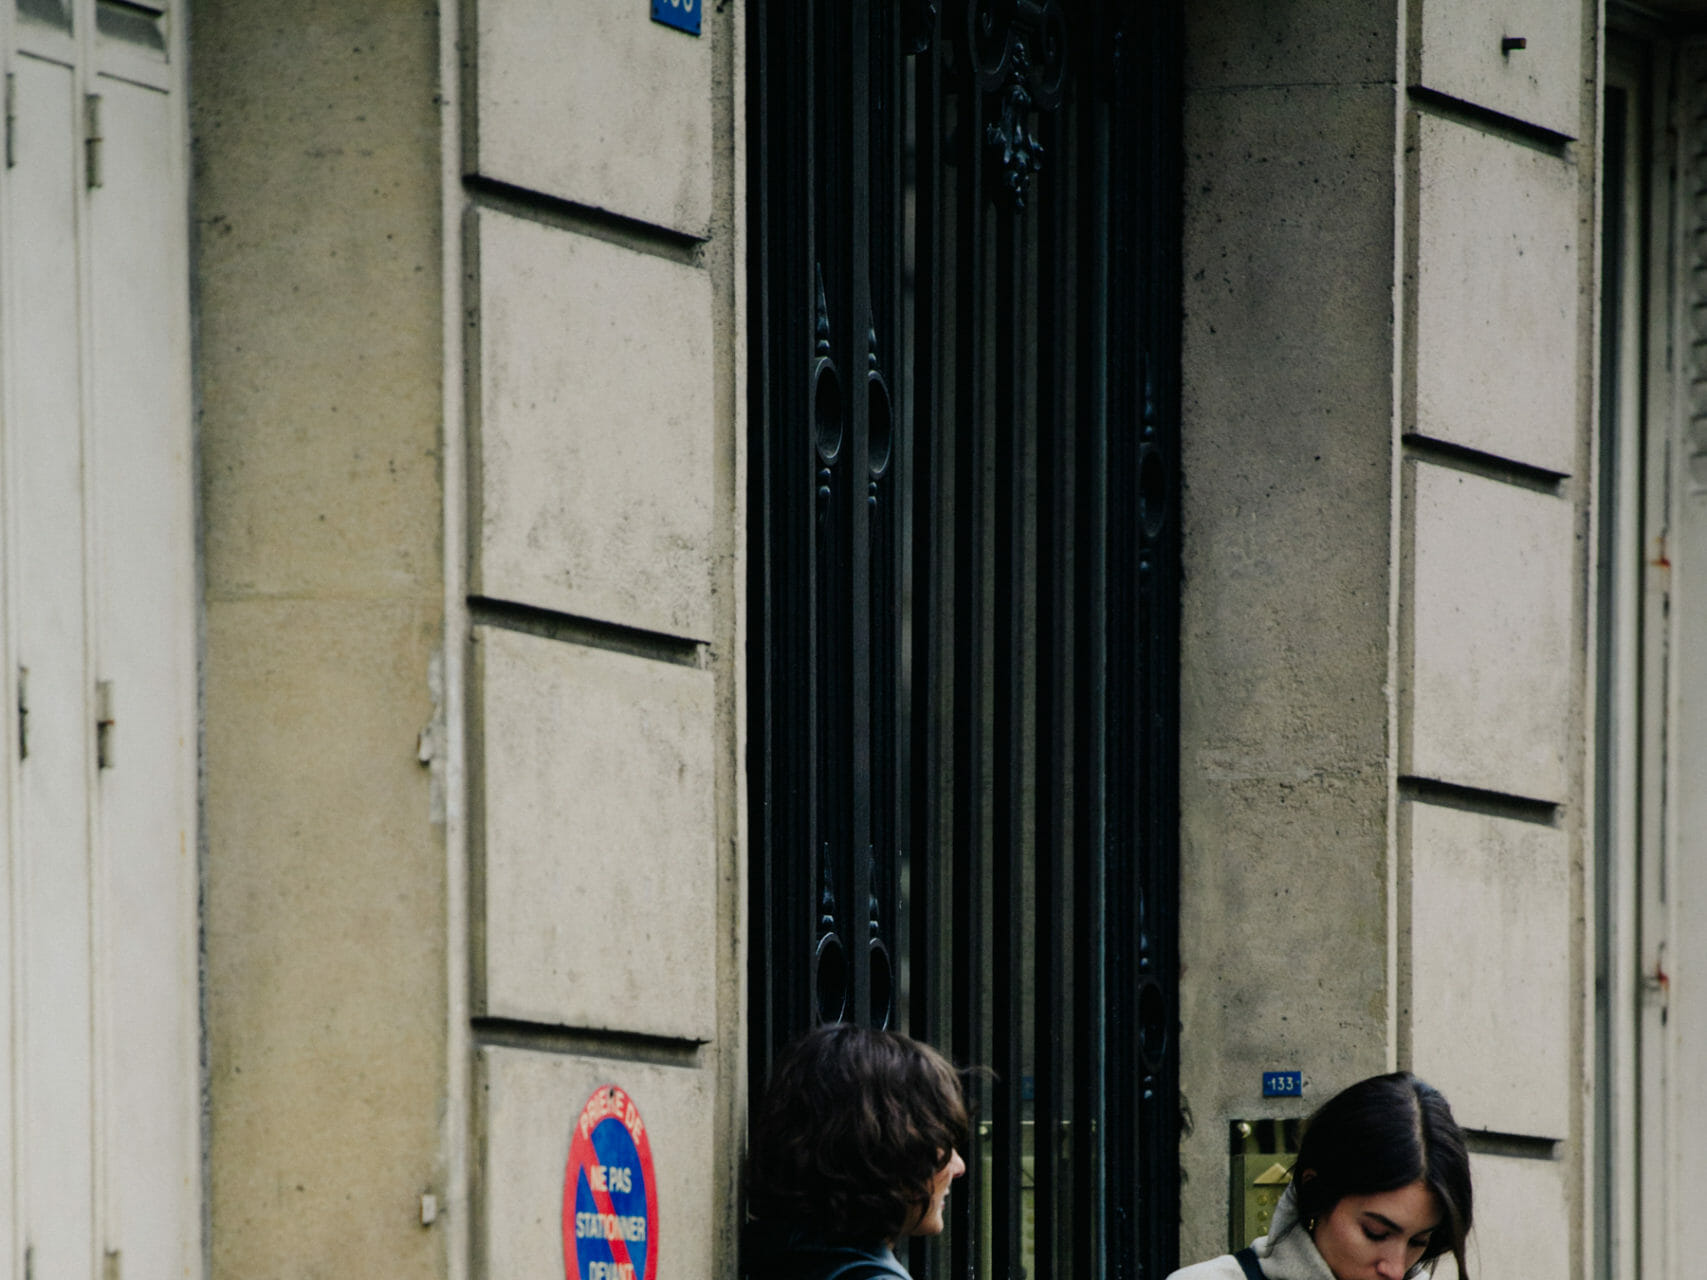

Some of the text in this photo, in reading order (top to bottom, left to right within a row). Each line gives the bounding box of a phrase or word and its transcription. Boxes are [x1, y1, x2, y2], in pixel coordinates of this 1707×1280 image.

[1271, 1076, 1294, 1091] 133
[625, 1102, 643, 1145] DE
[591, 1165, 632, 1194] NE PAS
[576, 1212, 646, 1242] STATIONNER
